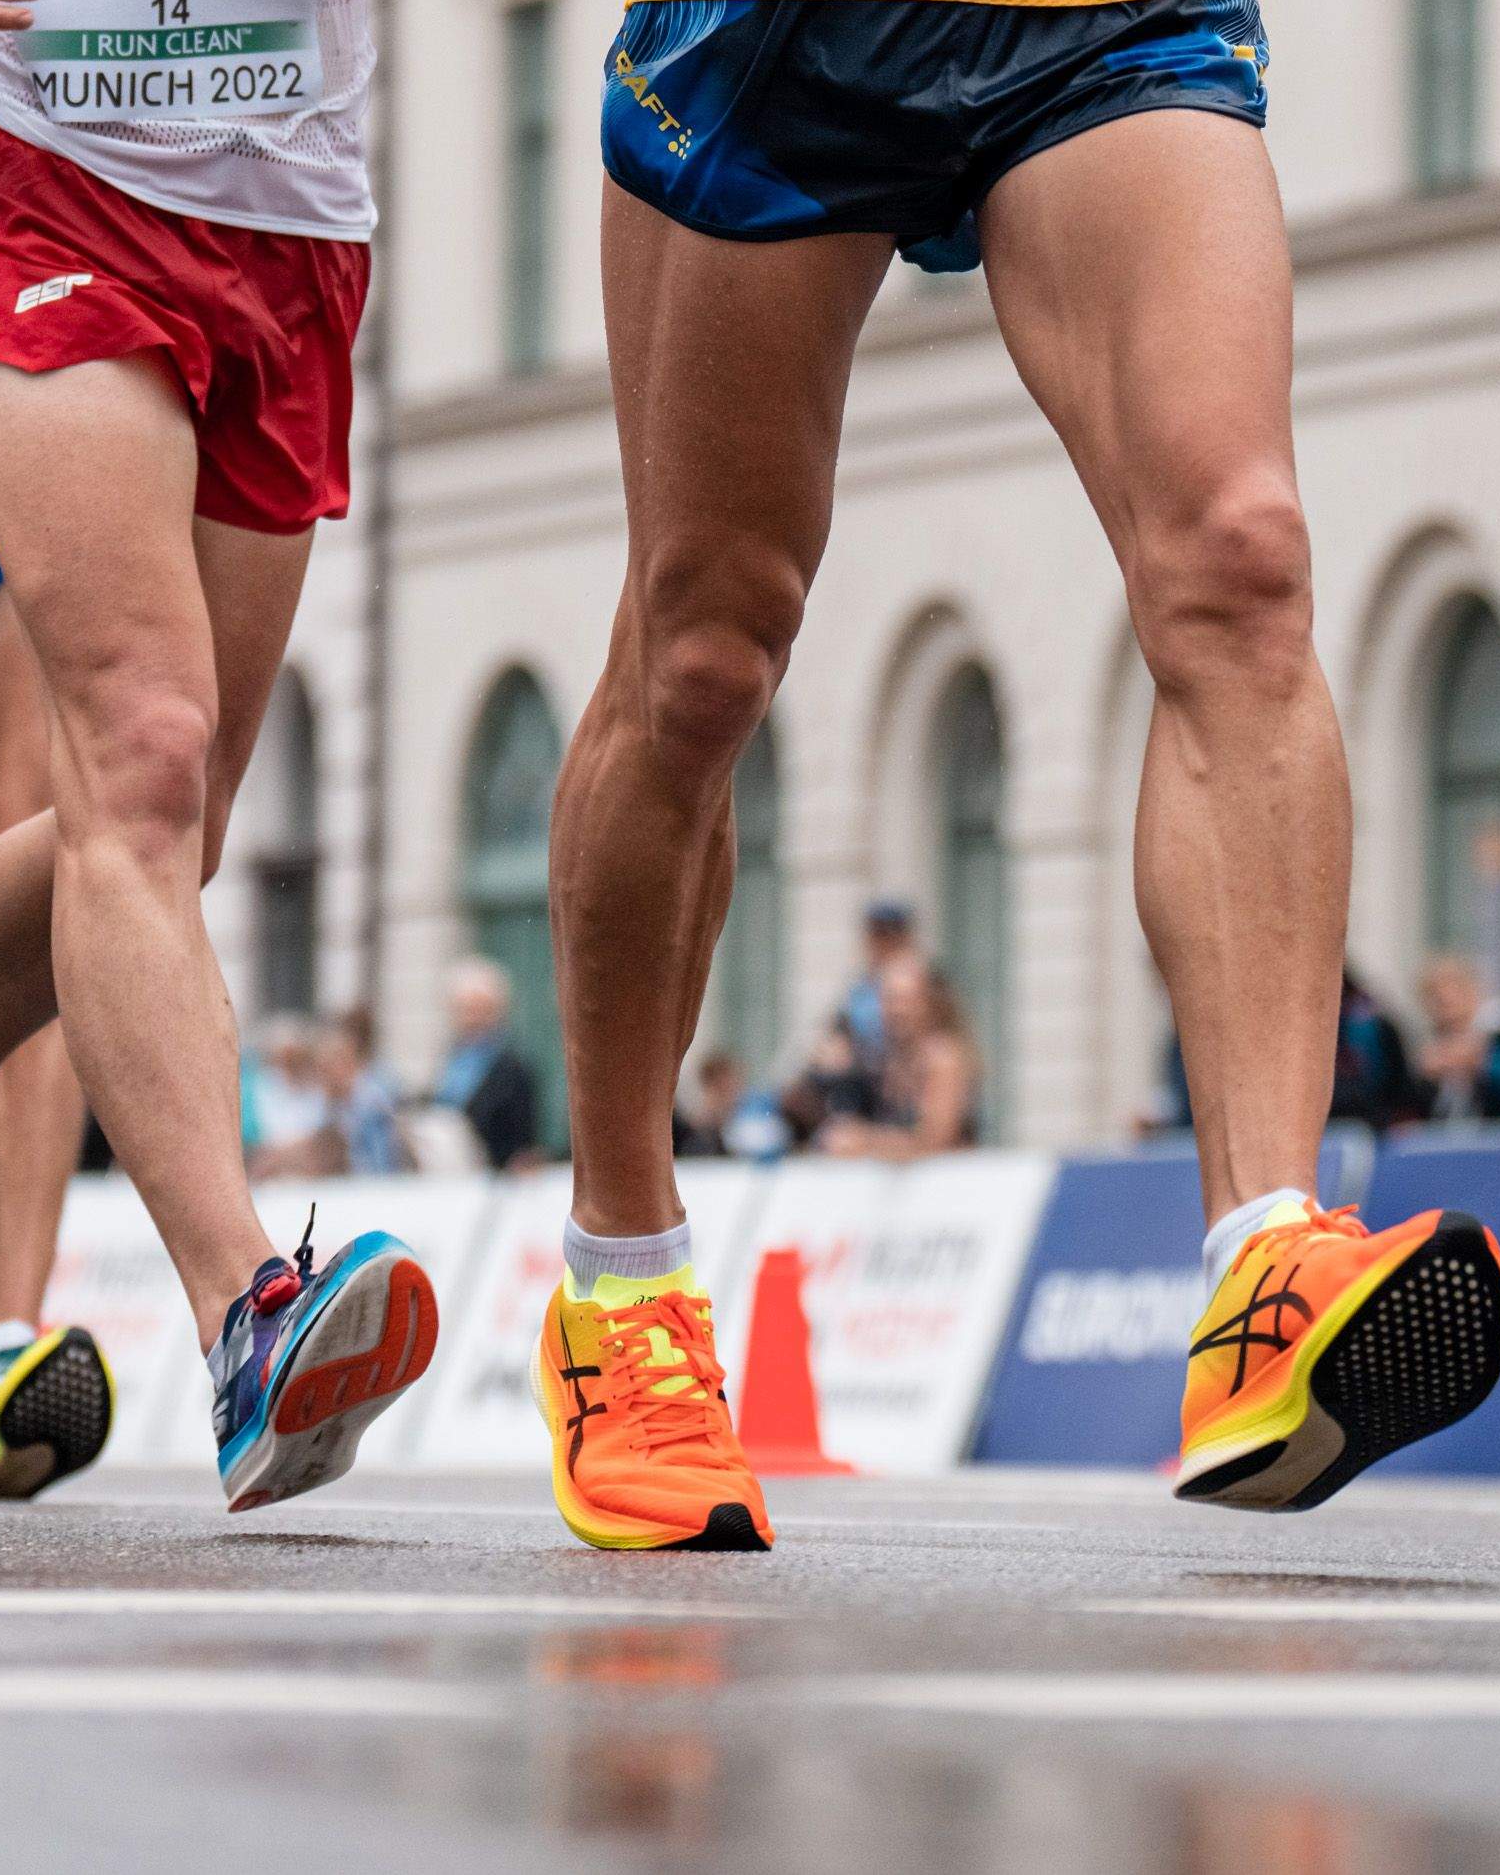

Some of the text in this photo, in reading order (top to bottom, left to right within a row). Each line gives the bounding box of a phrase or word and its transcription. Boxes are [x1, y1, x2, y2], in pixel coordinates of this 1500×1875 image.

[81, 33, 88, 56] I
[98, 32, 156, 56] RUN
[32, 62, 304, 109] MUNICH 2022
[14, 273, 94, 314] ESP
